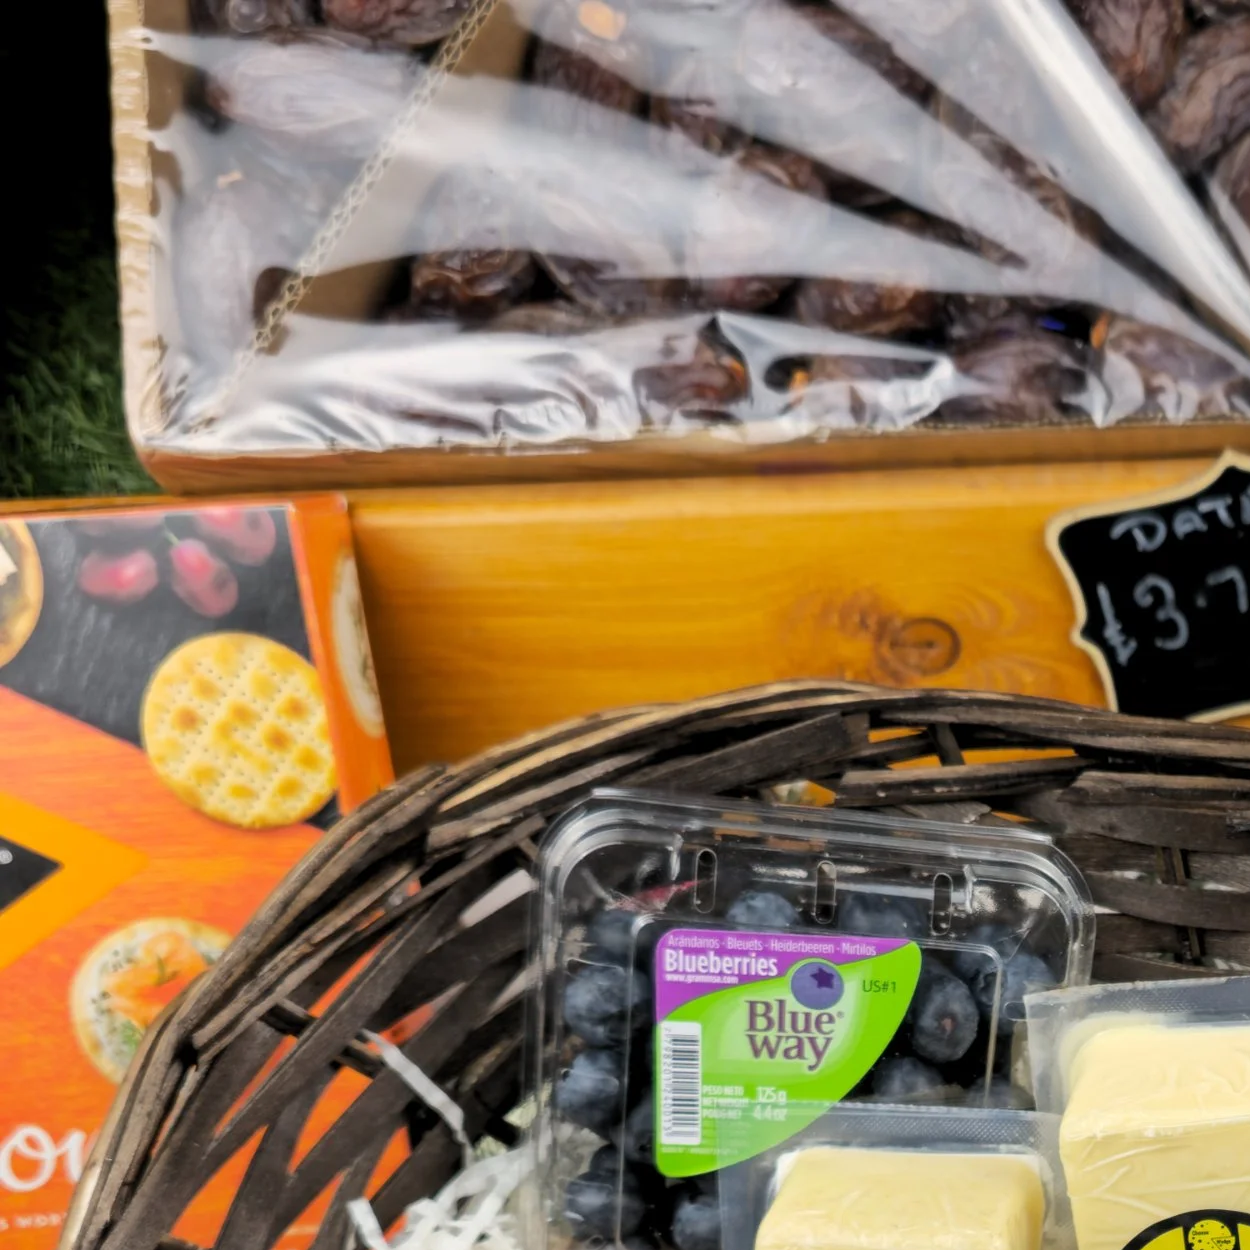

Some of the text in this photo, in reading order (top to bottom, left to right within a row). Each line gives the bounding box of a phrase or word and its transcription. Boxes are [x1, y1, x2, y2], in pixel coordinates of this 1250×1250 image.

[727, 937, 764, 951] Bleuets
[841, 943, 877, 956] Mirtilos
[665, 949, 779, 977] Blueberries
[861, 979, 897, 993] US#1
[745, 999, 836, 1035] Blue
[747, 1034, 834, 1072] way
